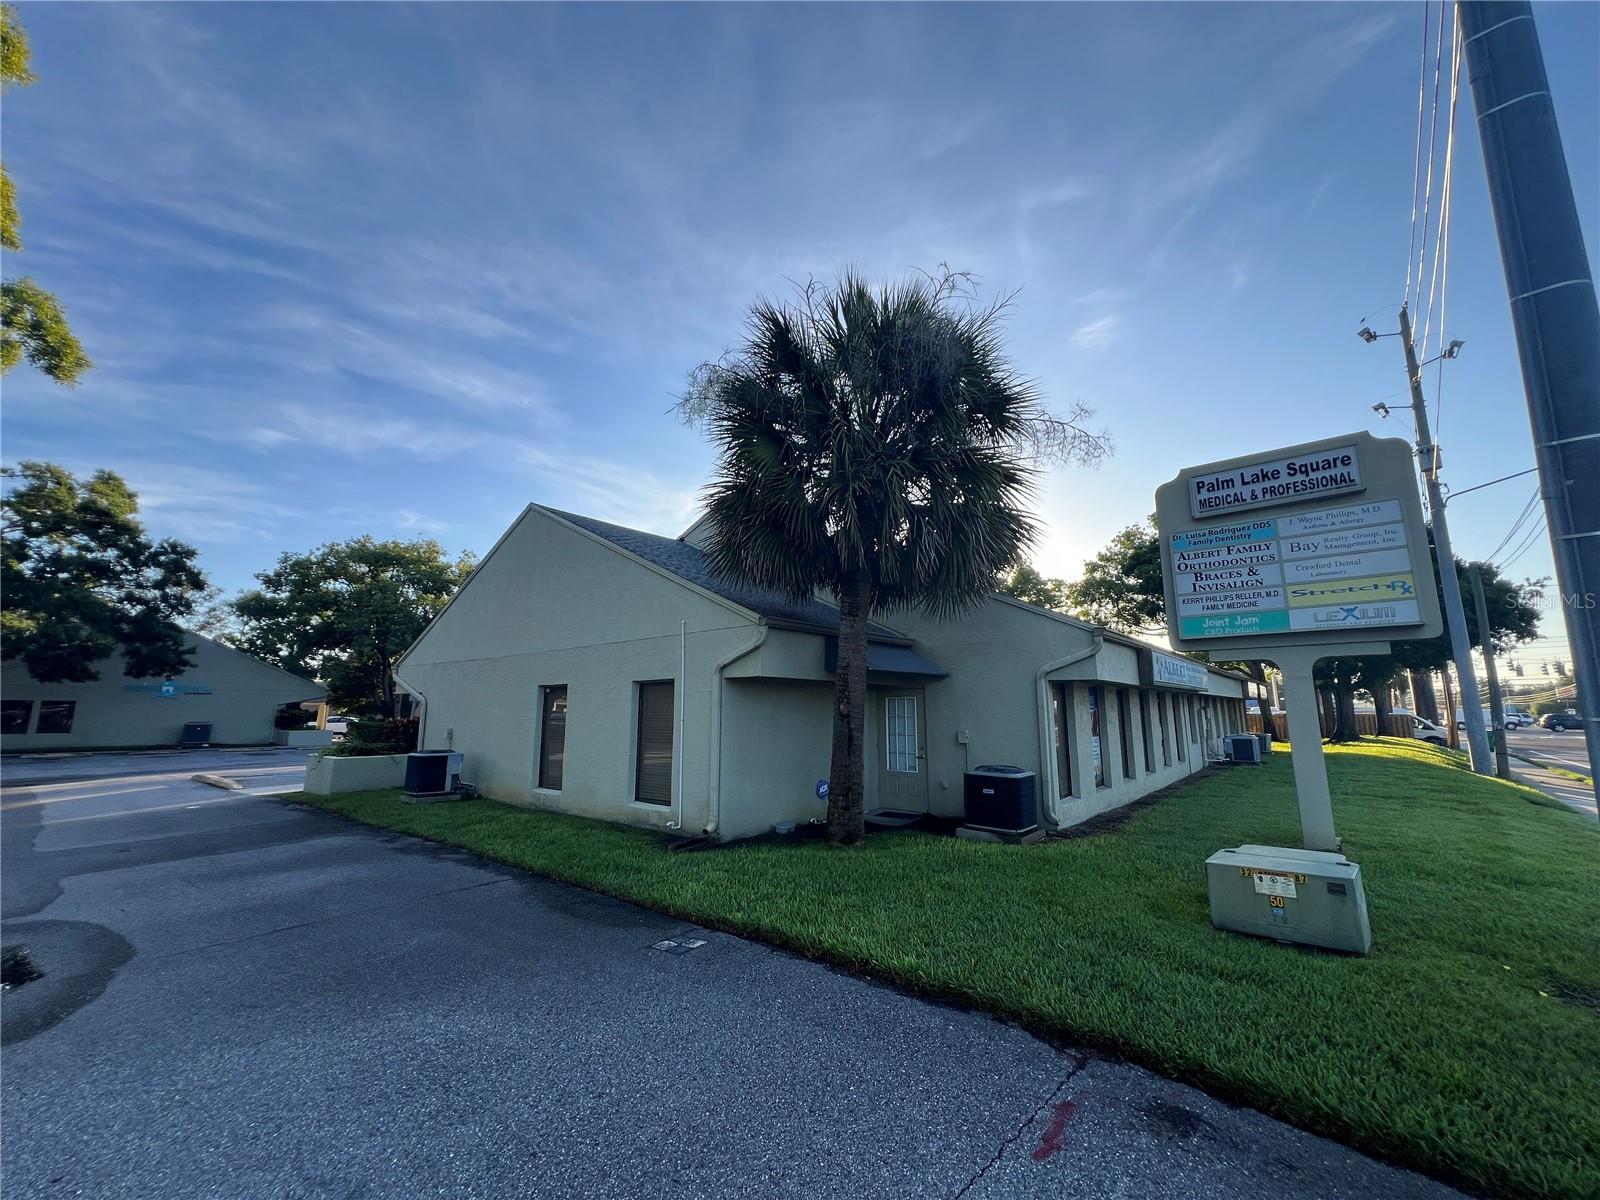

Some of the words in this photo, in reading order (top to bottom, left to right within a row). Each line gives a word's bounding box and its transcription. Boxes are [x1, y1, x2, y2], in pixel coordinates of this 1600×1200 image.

[1196, 477, 1235, 495] Palm
[1240, 467, 1281, 485] Lake
[1287, 453, 1352, 478] Square
[1199, 491, 1247, 510] MEDICAL
[1250, 489, 1258, 500] &
[1262, 471, 1355, 499] PROFESSIONAL
[1297, 515, 1323, 524] Wayne
[1186, 531, 1206, 540] Luisa
[1208, 525, 1251, 536] Rodriguez
[1253, 520, 1271, 530] DDS
[1188, 538, 1214, 547] Family
[1215, 532, 1252, 543] Dentistry
[1323, 534, 1349, 543] Realty
[1178, 549, 1222, 561] ALBERT
[1226, 543, 1272, 555] FAMILY
[1290, 541, 1320, 553] Bay
[1177, 553, 1276, 572] ORTHODONTICS
[1295, 561, 1332, 572] Crawford
[1335, 558, 1361, 568] Dental
[1194, 570, 1243, 582] BRACES
[1247, 566, 1259, 577] &
[1192, 578, 1264, 592] INVISALIGN
[1182, 596, 1204, 605] KERRY
[1205, 594, 1234, 603] PHILLIPS
[1235, 591, 1264, 601] RELLER,
[1202, 603, 1225, 612] FAMILY
[1226, 601, 1259, 609] MEDICINE
[1202, 617, 1230, 627] Joint
[1234, 615, 1260, 625] Jam
[1269, 896, 1284, 908] 50
